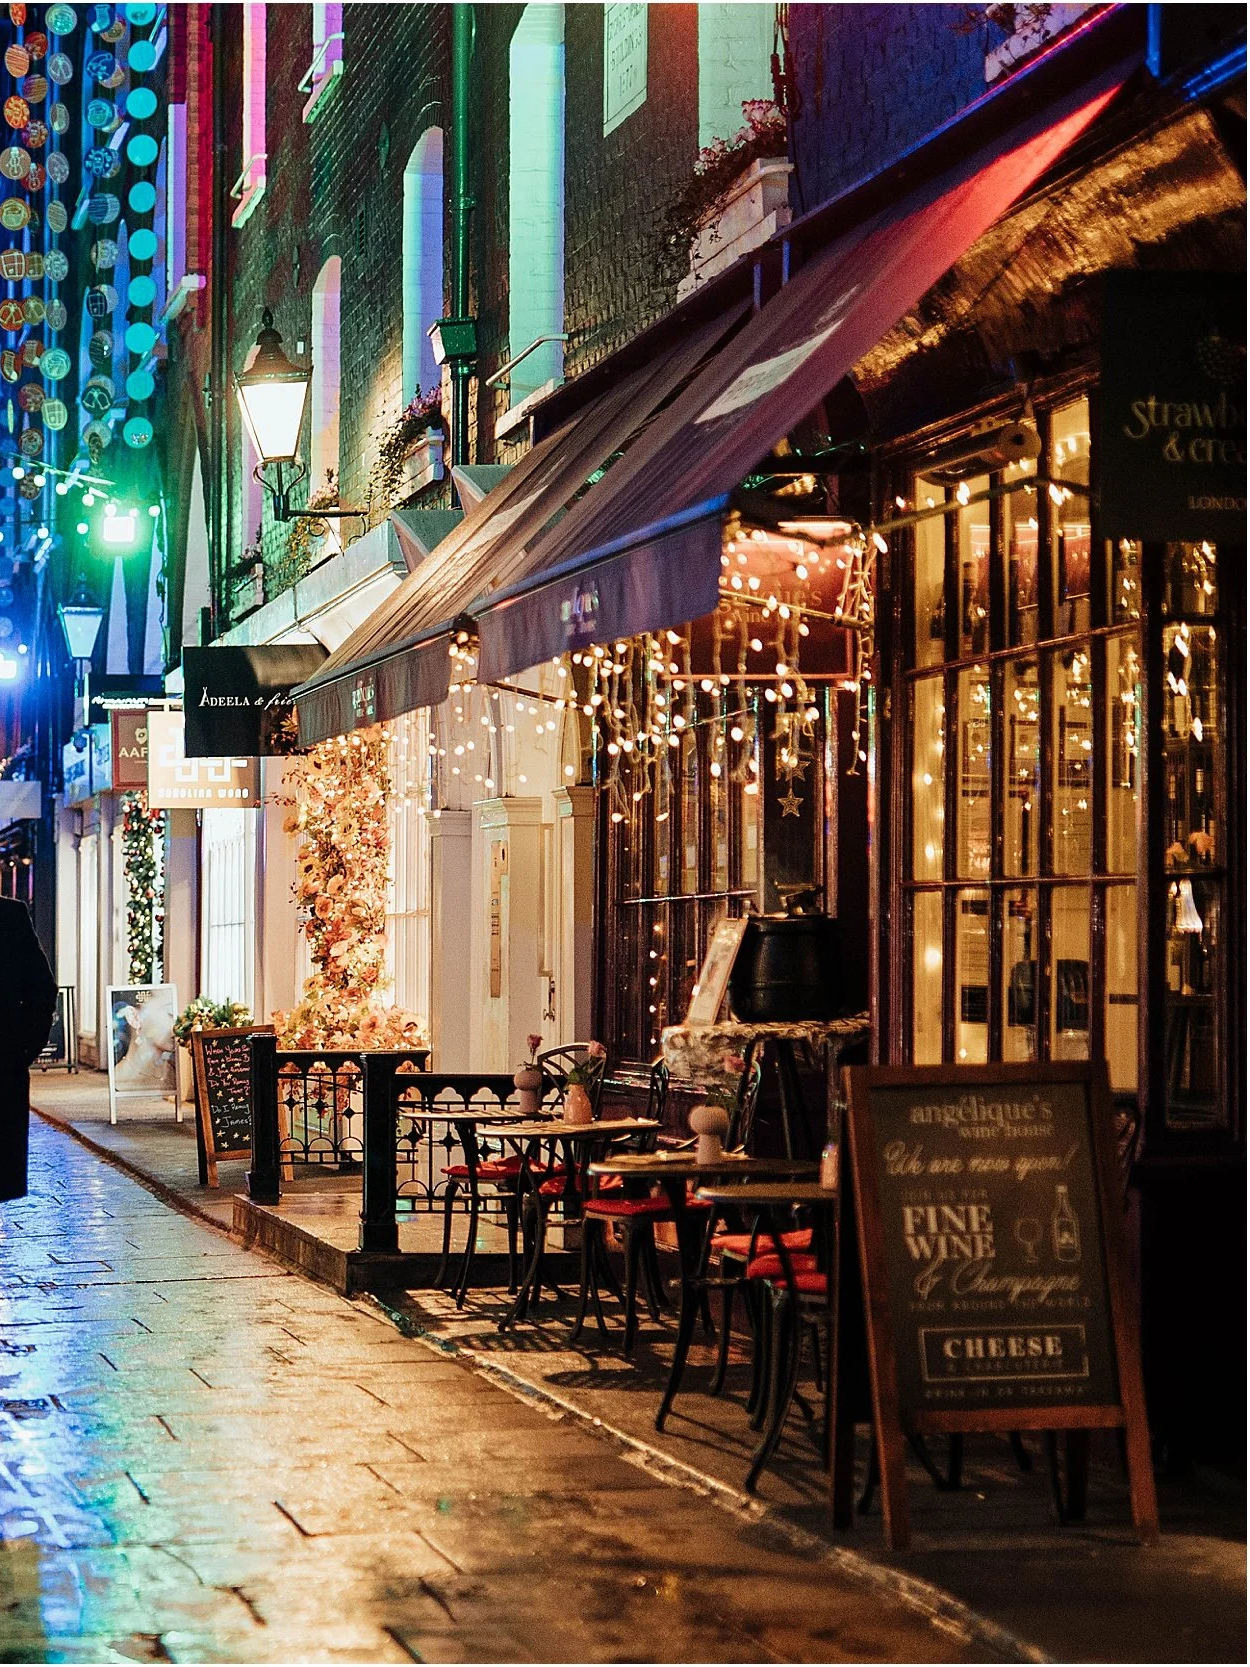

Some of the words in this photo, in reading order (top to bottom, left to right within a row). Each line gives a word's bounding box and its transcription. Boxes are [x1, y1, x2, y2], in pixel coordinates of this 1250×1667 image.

[1163, 432, 1185, 463] &
[198, 686, 250, 707] ADEELA
[254, 696, 264, 706] &
[884, 1141, 924, 1175] We
[929, 1158, 964, 1174] are
[969, 1157, 1011, 1173] now
[903, 1205, 993, 1234] FINE
[905, 1233, 996, 1260] WINE
[953, 1250, 1082, 1303] Champagne
[943, 1335, 1063, 1359] CHEESE
